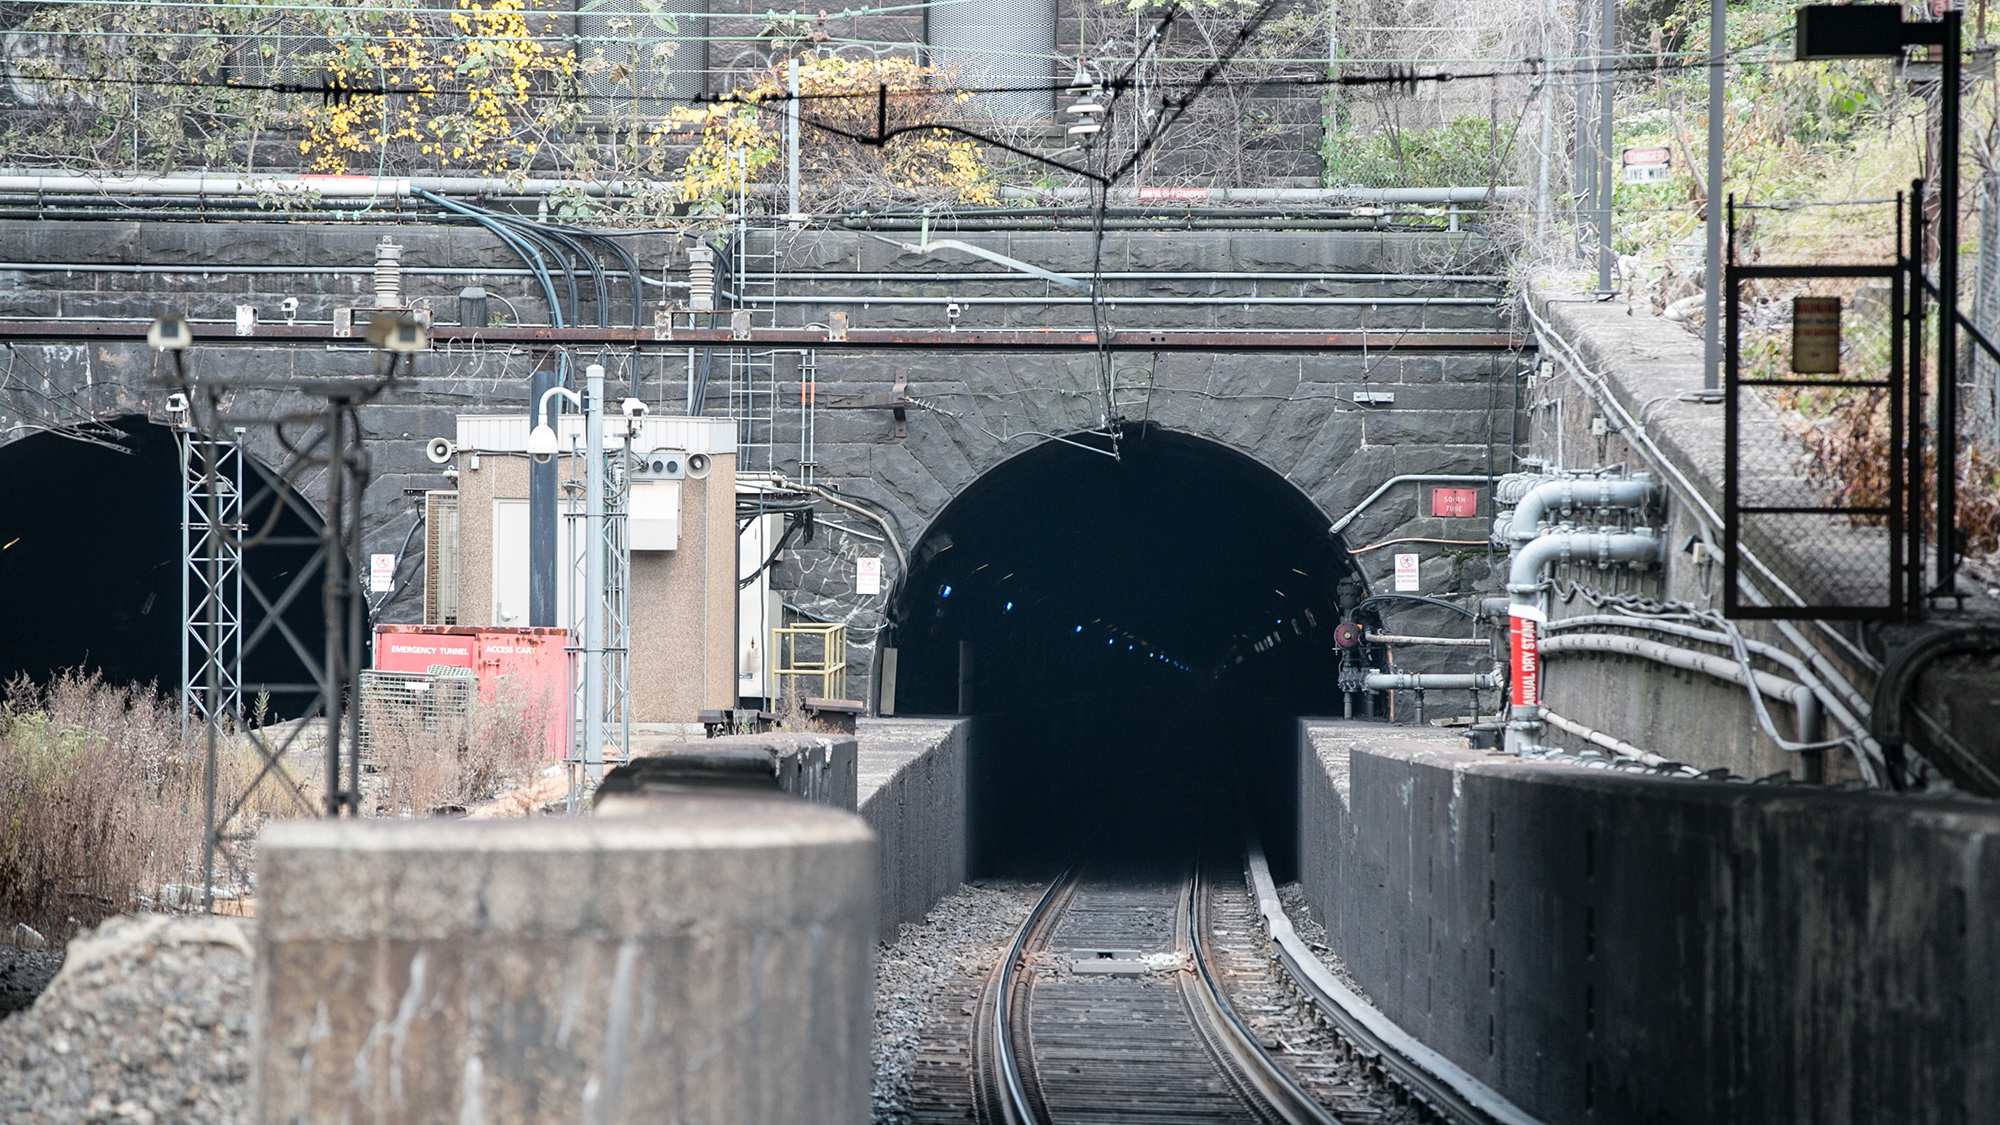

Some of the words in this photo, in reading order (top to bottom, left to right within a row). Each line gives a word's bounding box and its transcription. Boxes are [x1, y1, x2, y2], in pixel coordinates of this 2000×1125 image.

[1628, 150, 1664, 162] DANGER
[1624, 168, 1643, 181] LIVE
[1648, 167, 1670, 179] WIRE
[391, 645, 437, 655] EMERGENCY
[439, 647, 469, 655] TUNNEL
[1521, 651, 1535, 672] DRY
